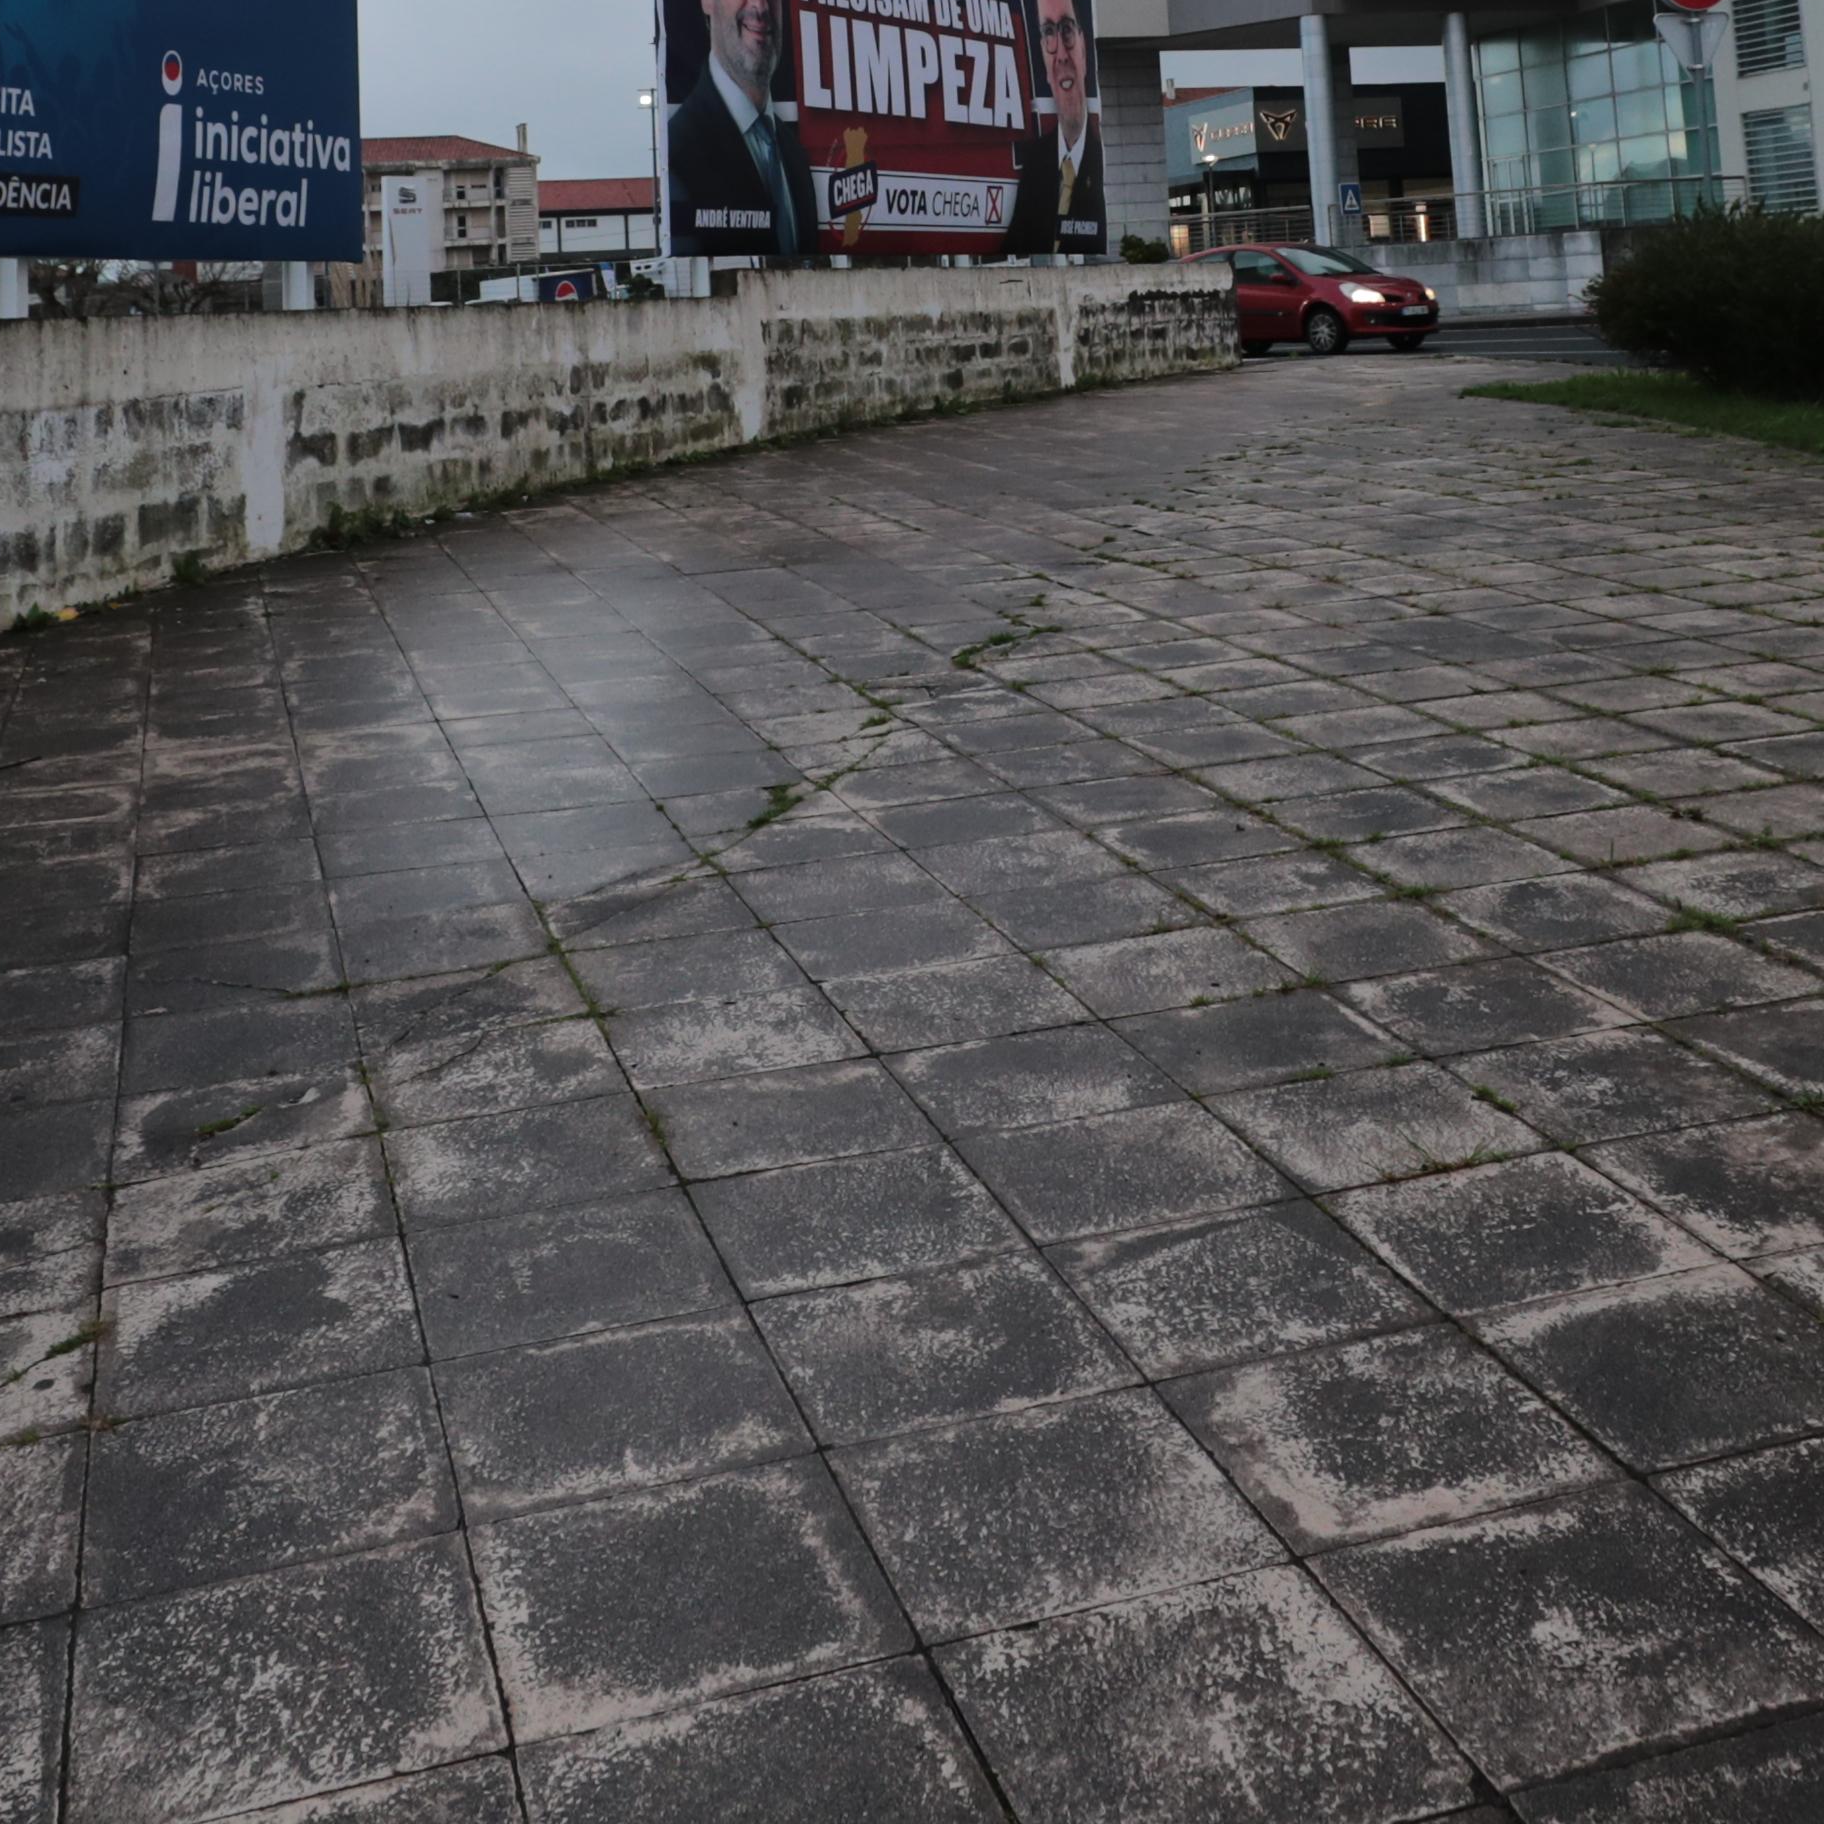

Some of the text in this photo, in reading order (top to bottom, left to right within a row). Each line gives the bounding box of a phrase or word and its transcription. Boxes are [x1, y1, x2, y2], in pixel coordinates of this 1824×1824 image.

[196, 68, 265, 95] AÇORES
[799, 9, 1025, 130] LIMPEZA
[195, 106, 351, 172] iniciativa
[189, 170, 308, 227] liberal
[833, 169, 874, 207] CHEGA
[885, 188, 980, 218] VOTA CHEGA
[695, 206, 771, 229] ANDRÉ VENTURA
